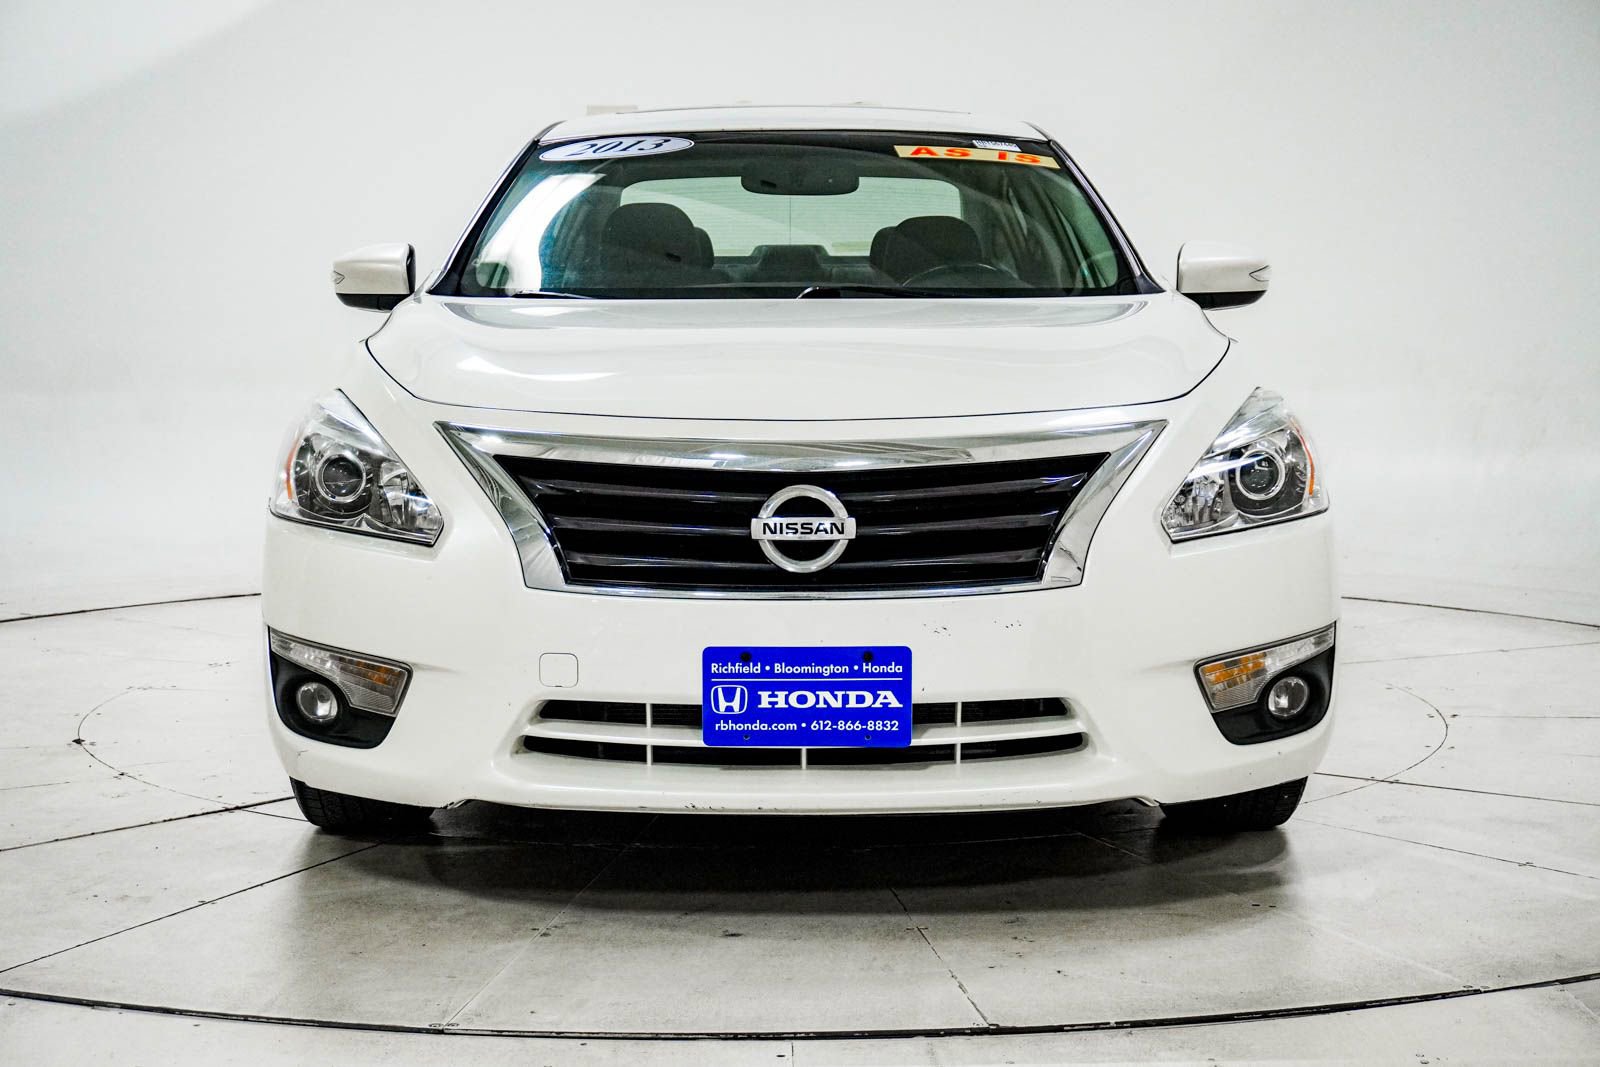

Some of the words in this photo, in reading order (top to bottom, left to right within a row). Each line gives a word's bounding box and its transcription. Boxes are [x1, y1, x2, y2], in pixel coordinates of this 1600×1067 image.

[566, 139, 671, 156] 2013
[910, 146, 972, 158] AS
[998, 151, 1041, 163] IS
[762, 522, 845, 535] NISSAN
[711, 662, 761, 674] Richfield
[774, 662, 849, 677] Bloomington
[862, 661, 903, 673] Honda
[757, 690, 904, 708] HONDA
[715, 719, 798, 731] rbhonda.com
[810, 720, 899, 731] 612-866-8832
